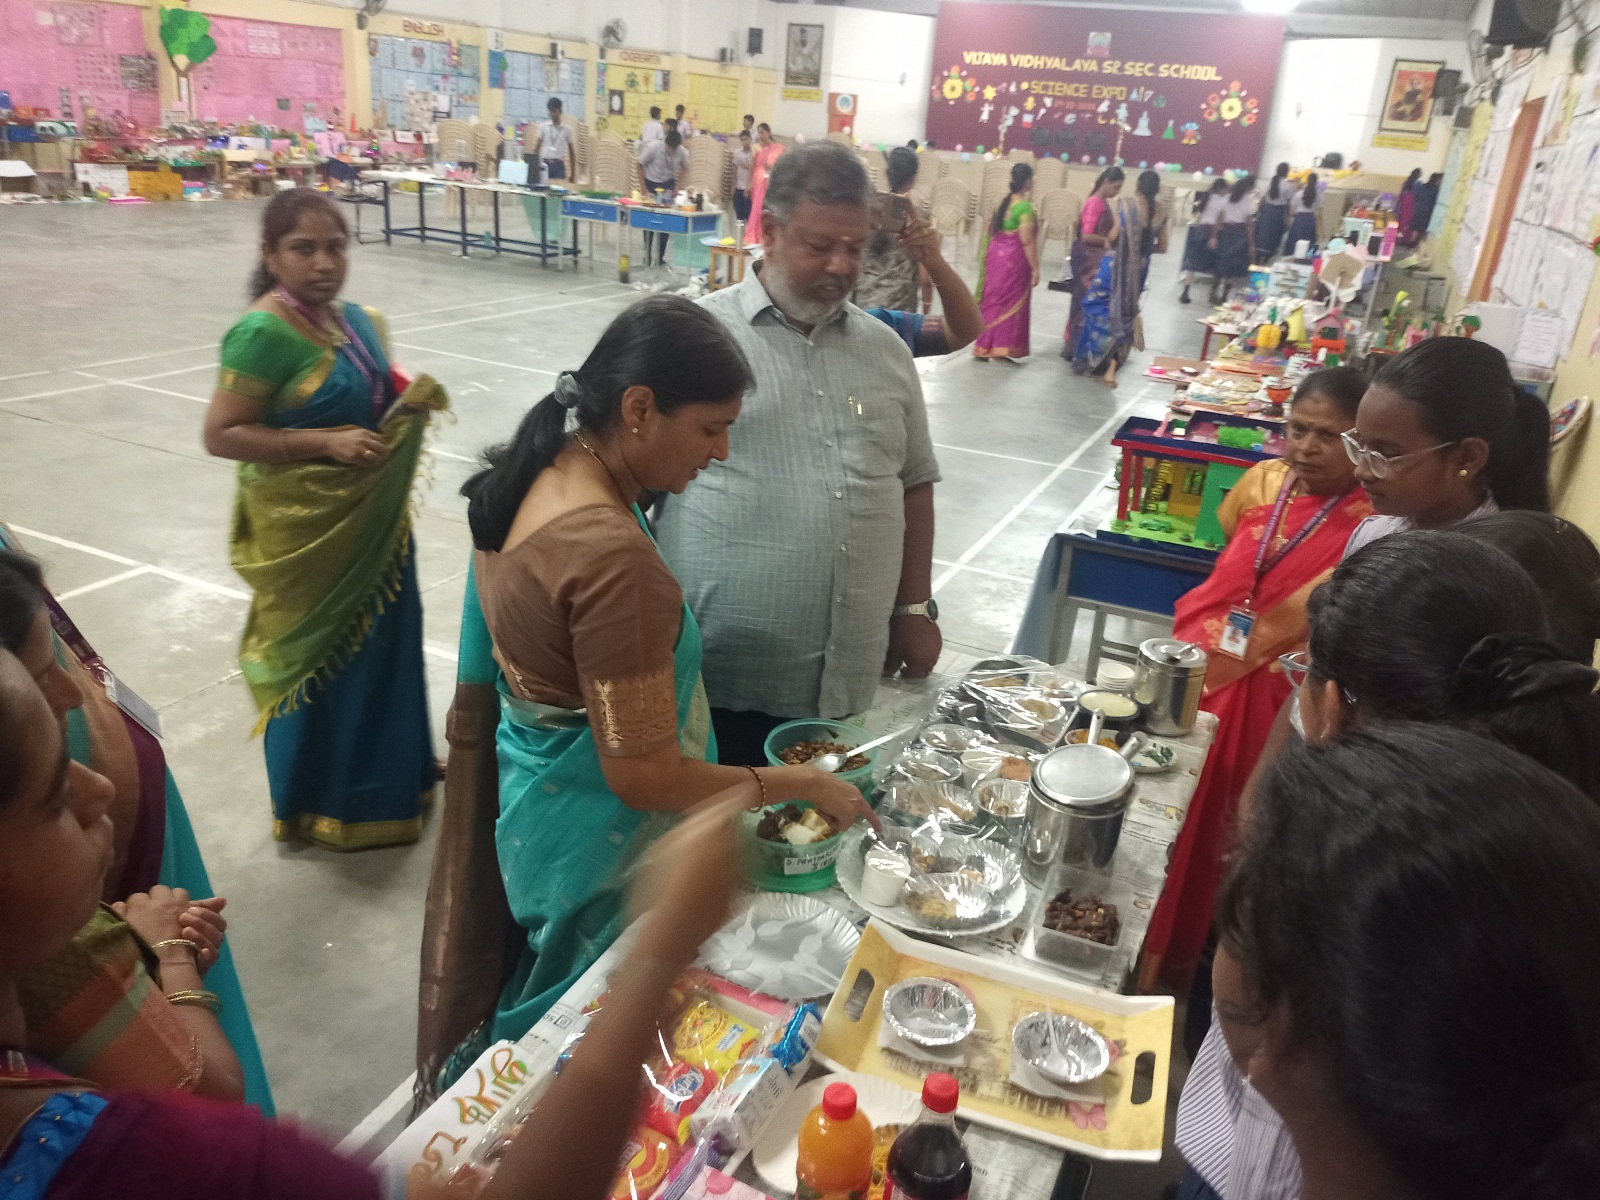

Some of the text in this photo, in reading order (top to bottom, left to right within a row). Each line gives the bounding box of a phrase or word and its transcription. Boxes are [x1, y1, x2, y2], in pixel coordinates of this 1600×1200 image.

[963, 51, 1008, 67] VIJAYA
[1009, 53, 1099, 73] VIDHYALAYA
[1158, 64, 1222, 80] SCHOOL
[1030, 80, 1127, 101] SCIENCE EXPO
